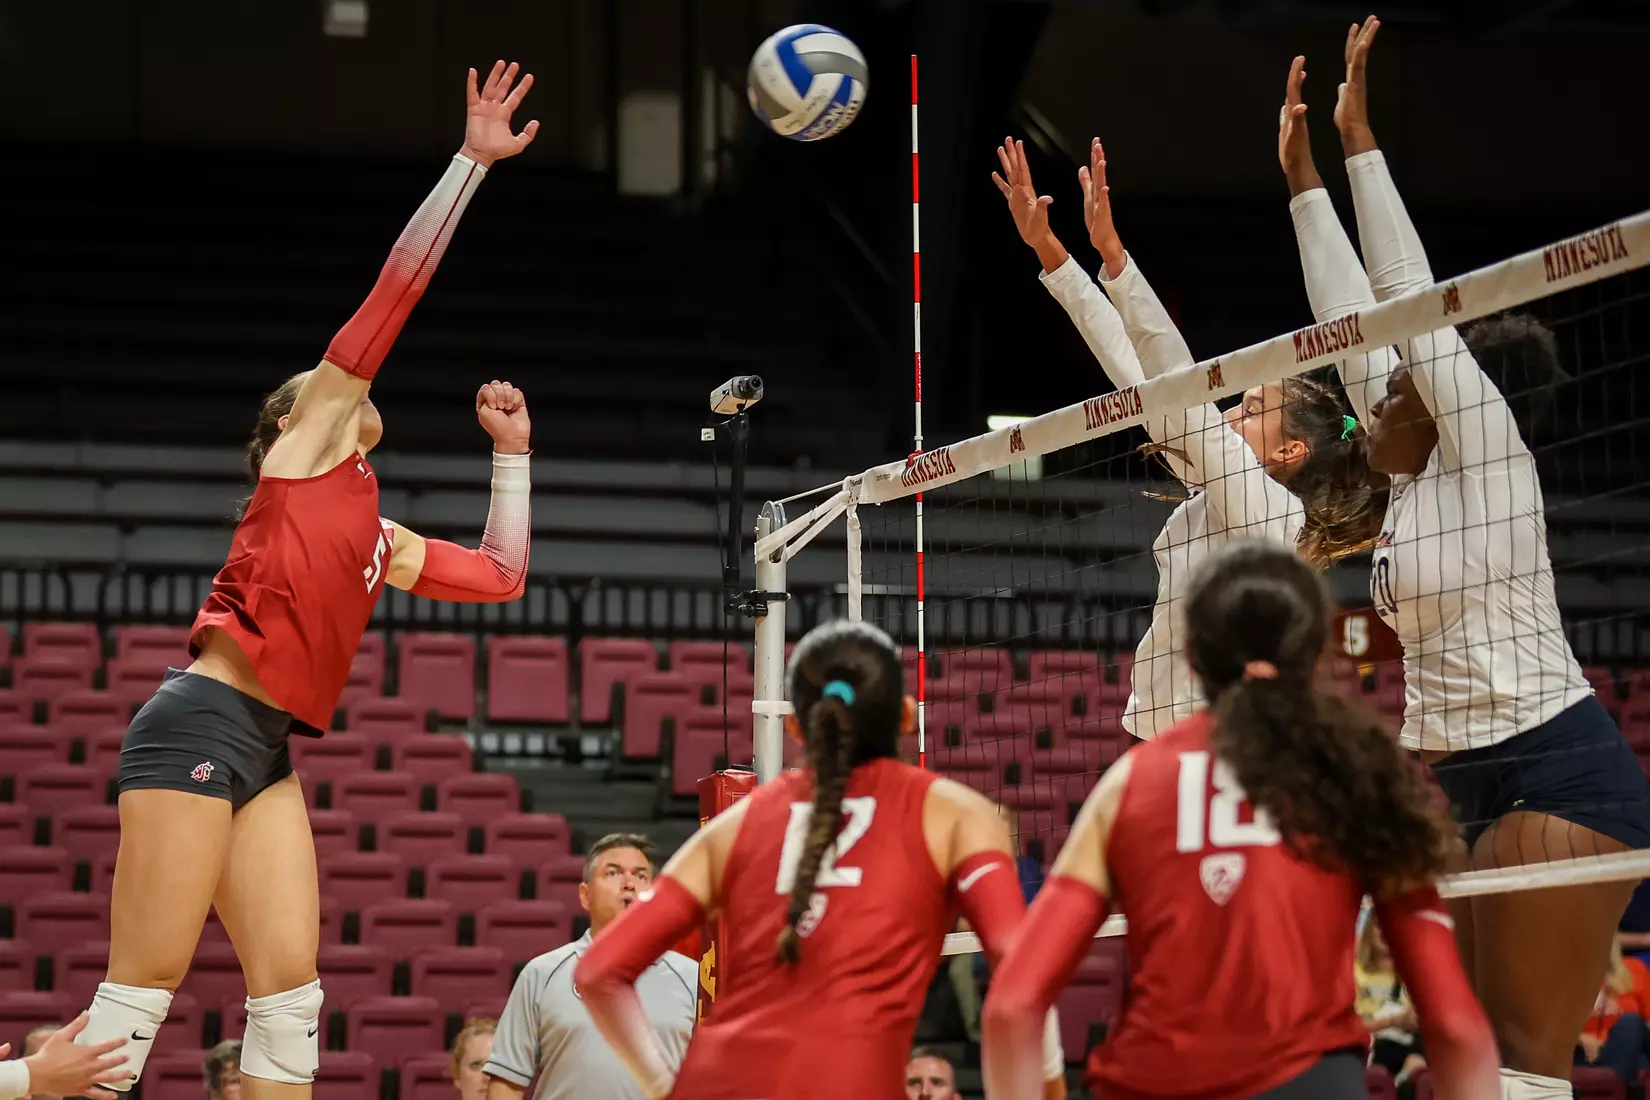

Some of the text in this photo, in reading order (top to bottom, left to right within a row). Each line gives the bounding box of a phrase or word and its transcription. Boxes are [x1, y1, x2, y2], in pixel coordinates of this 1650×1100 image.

[1543, 222, 1629, 283] MINNESOTA
[1293, 311, 1364, 364] MINNESOTA
[1083, 384, 1143, 431] MINNESOTA
[901, 446, 956, 487] MINNESOTA
[363, 532, 387, 594] 5
[1176, 751, 1282, 854] 18
[775, 796, 876, 894] 12
